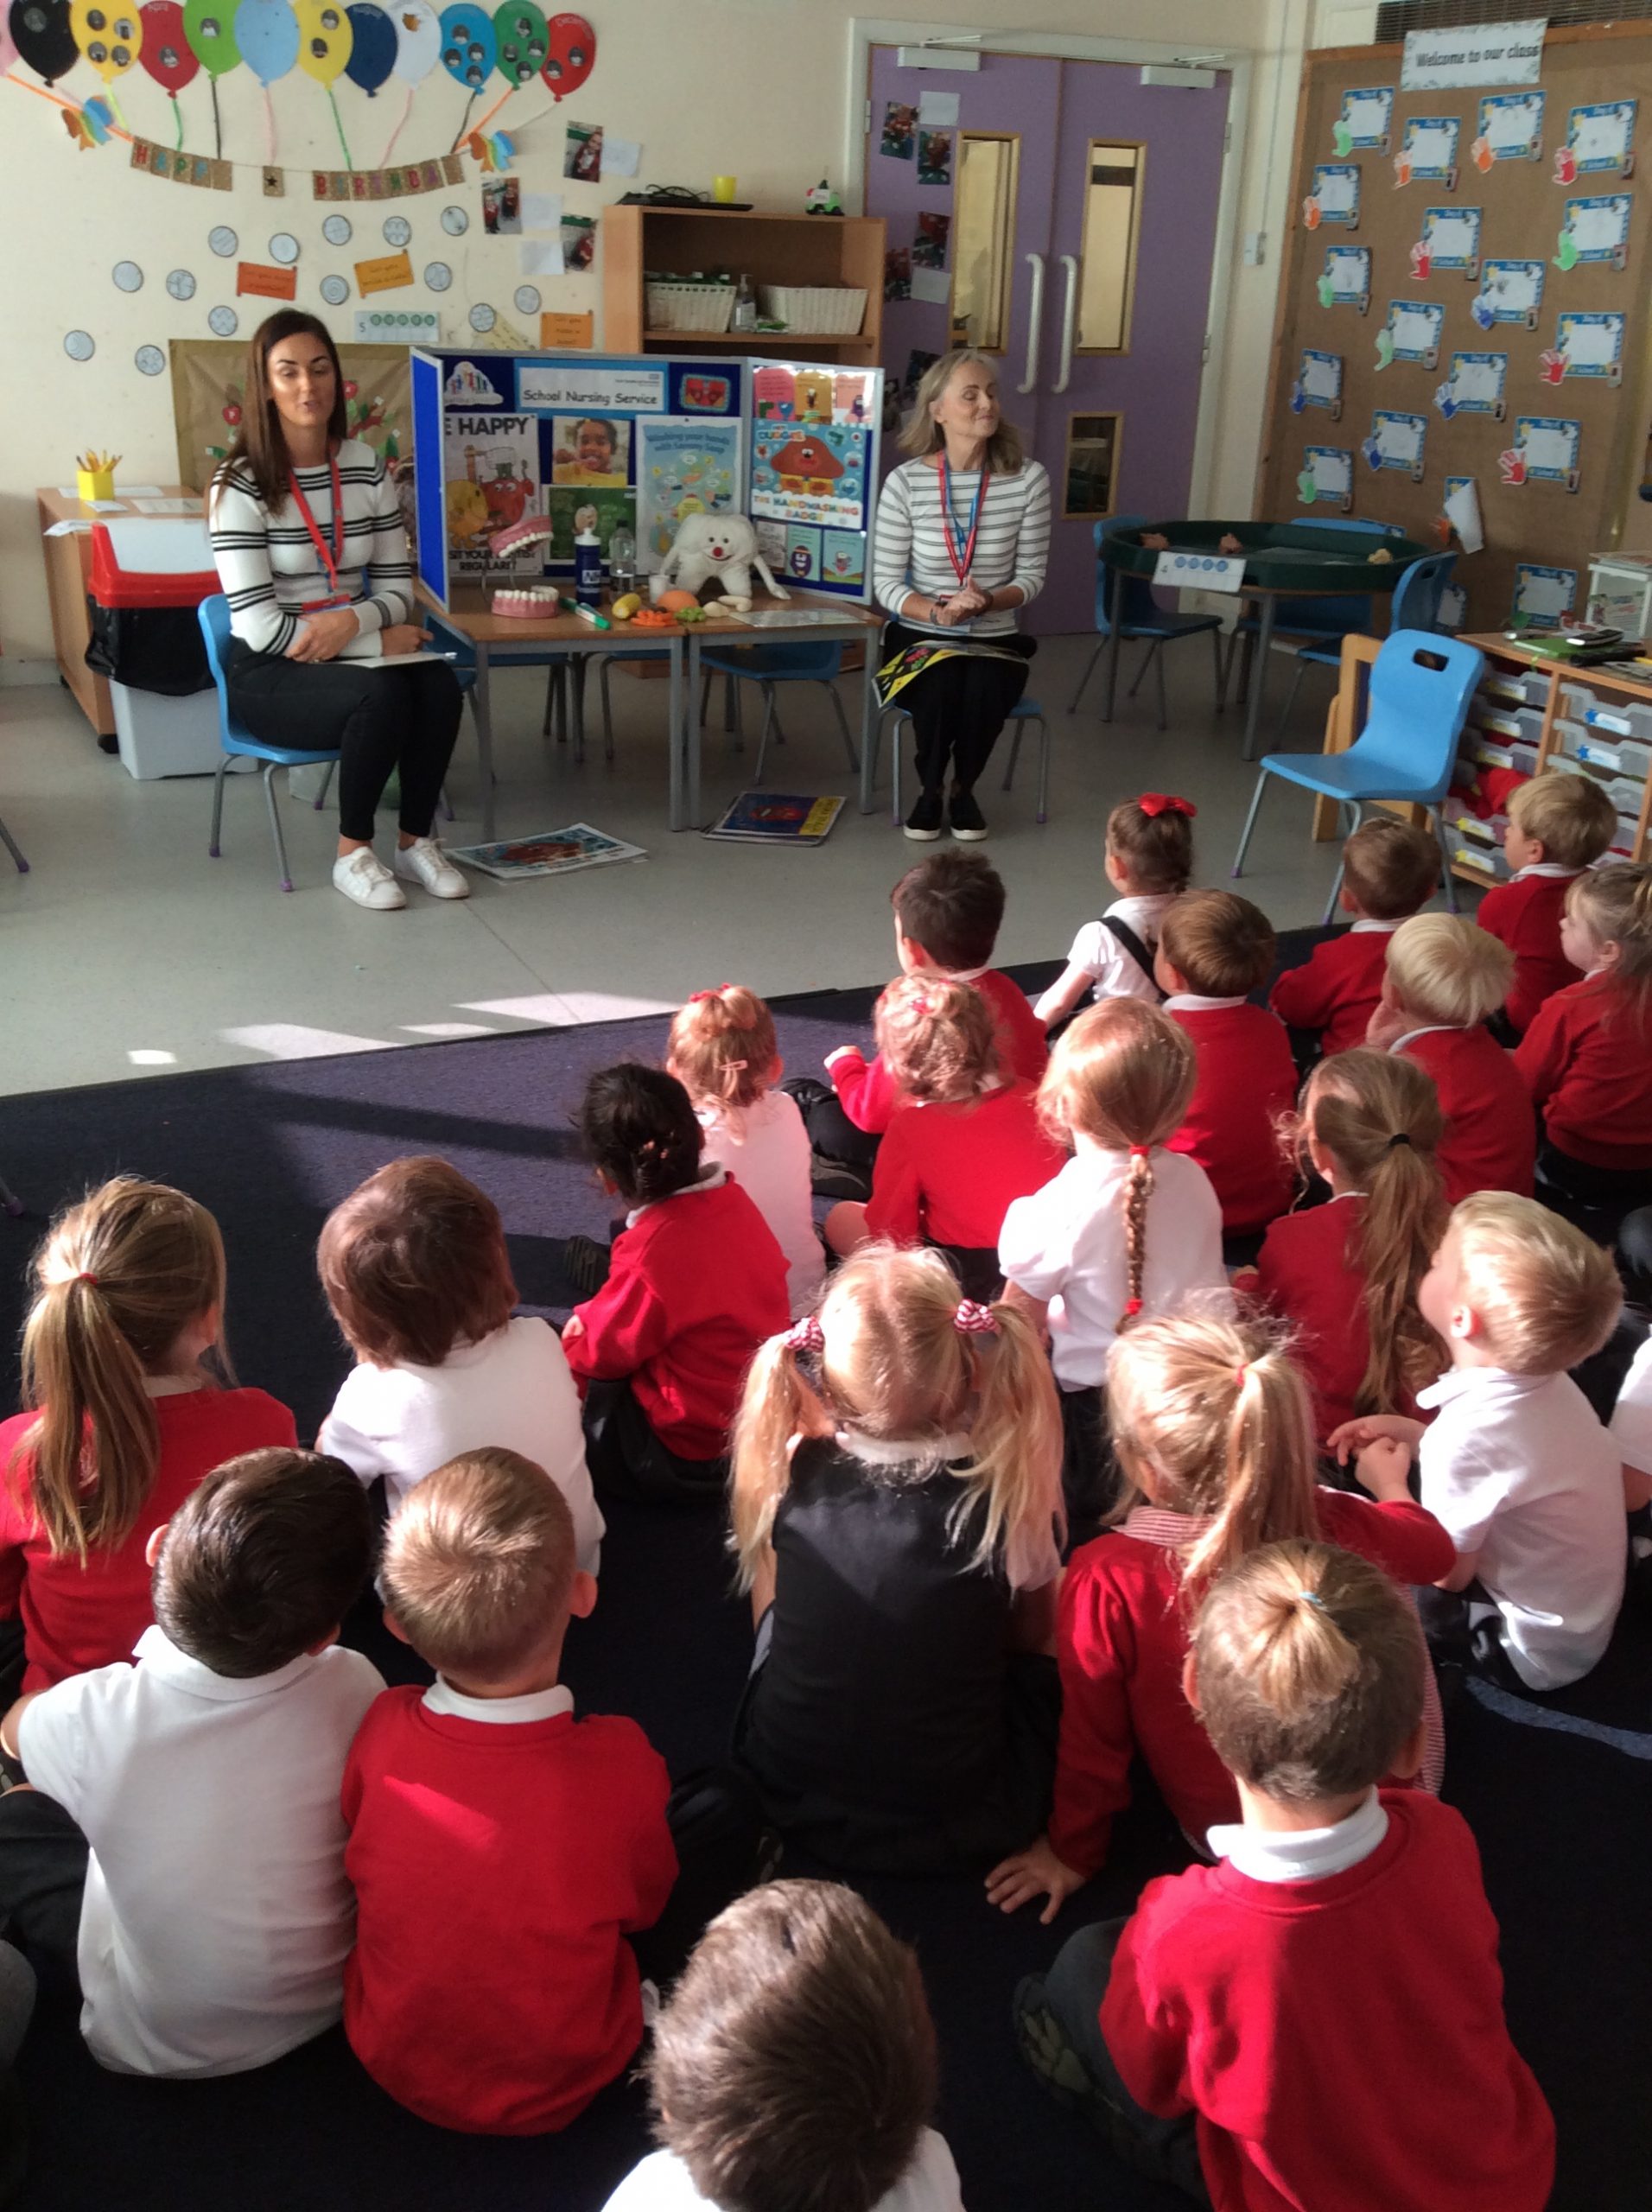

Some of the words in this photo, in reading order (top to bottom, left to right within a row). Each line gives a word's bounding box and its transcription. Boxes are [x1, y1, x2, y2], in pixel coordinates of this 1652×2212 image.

[1416, 50, 1465, 67] Welcome
[1468, 49, 1481, 63] to
[1484, 48, 1505, 60] our
[1508, 42, 1539, 58] class
[523, 389, 561, 402] School
[566, 391, 610, 406] Nursing
[614, 392, 658, 405] Service
[444, 417, 452, 435] E
[458, 417, 529, 435] HAPPY
